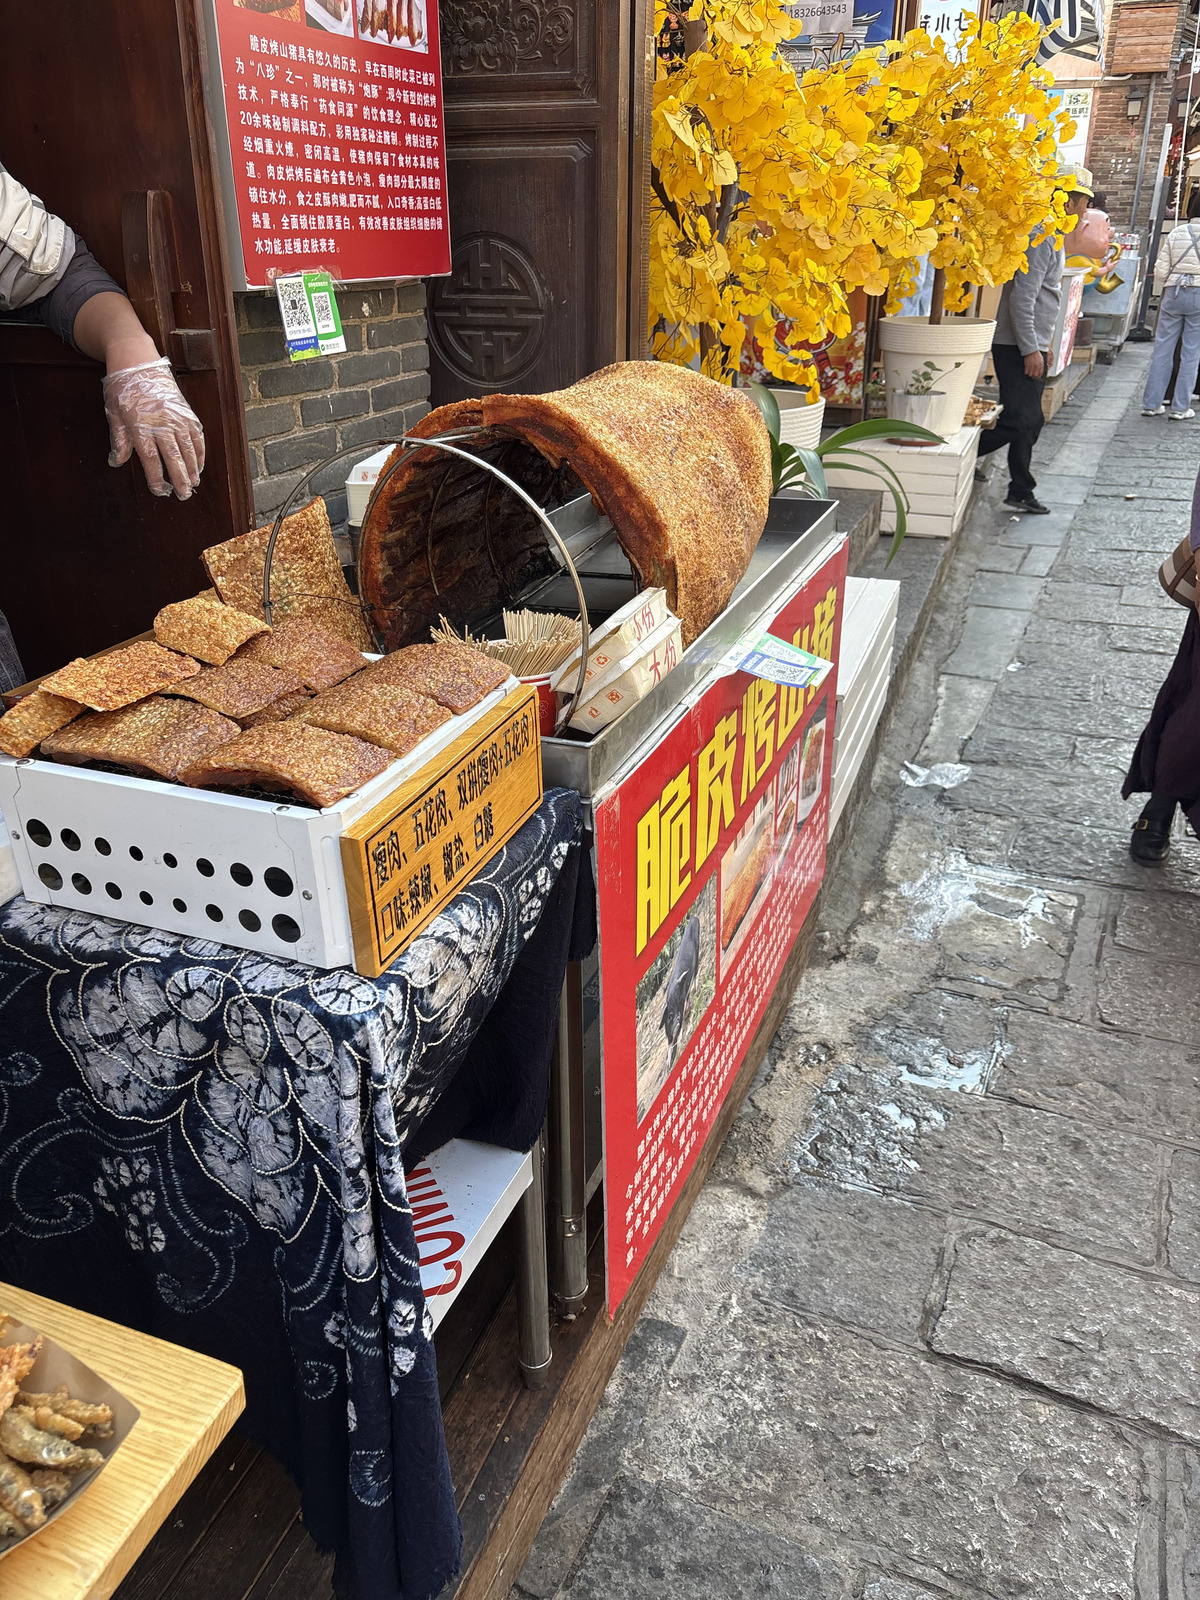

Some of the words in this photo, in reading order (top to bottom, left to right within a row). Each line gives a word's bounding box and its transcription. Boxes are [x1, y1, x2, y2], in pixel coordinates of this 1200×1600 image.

[790, 4, 847, 18] 18326643543
[633, 602, 655, 642] 小份
[649, 637, 677, 688] 大份
[636, 586, 837, 957] 脆皮烤山猪
